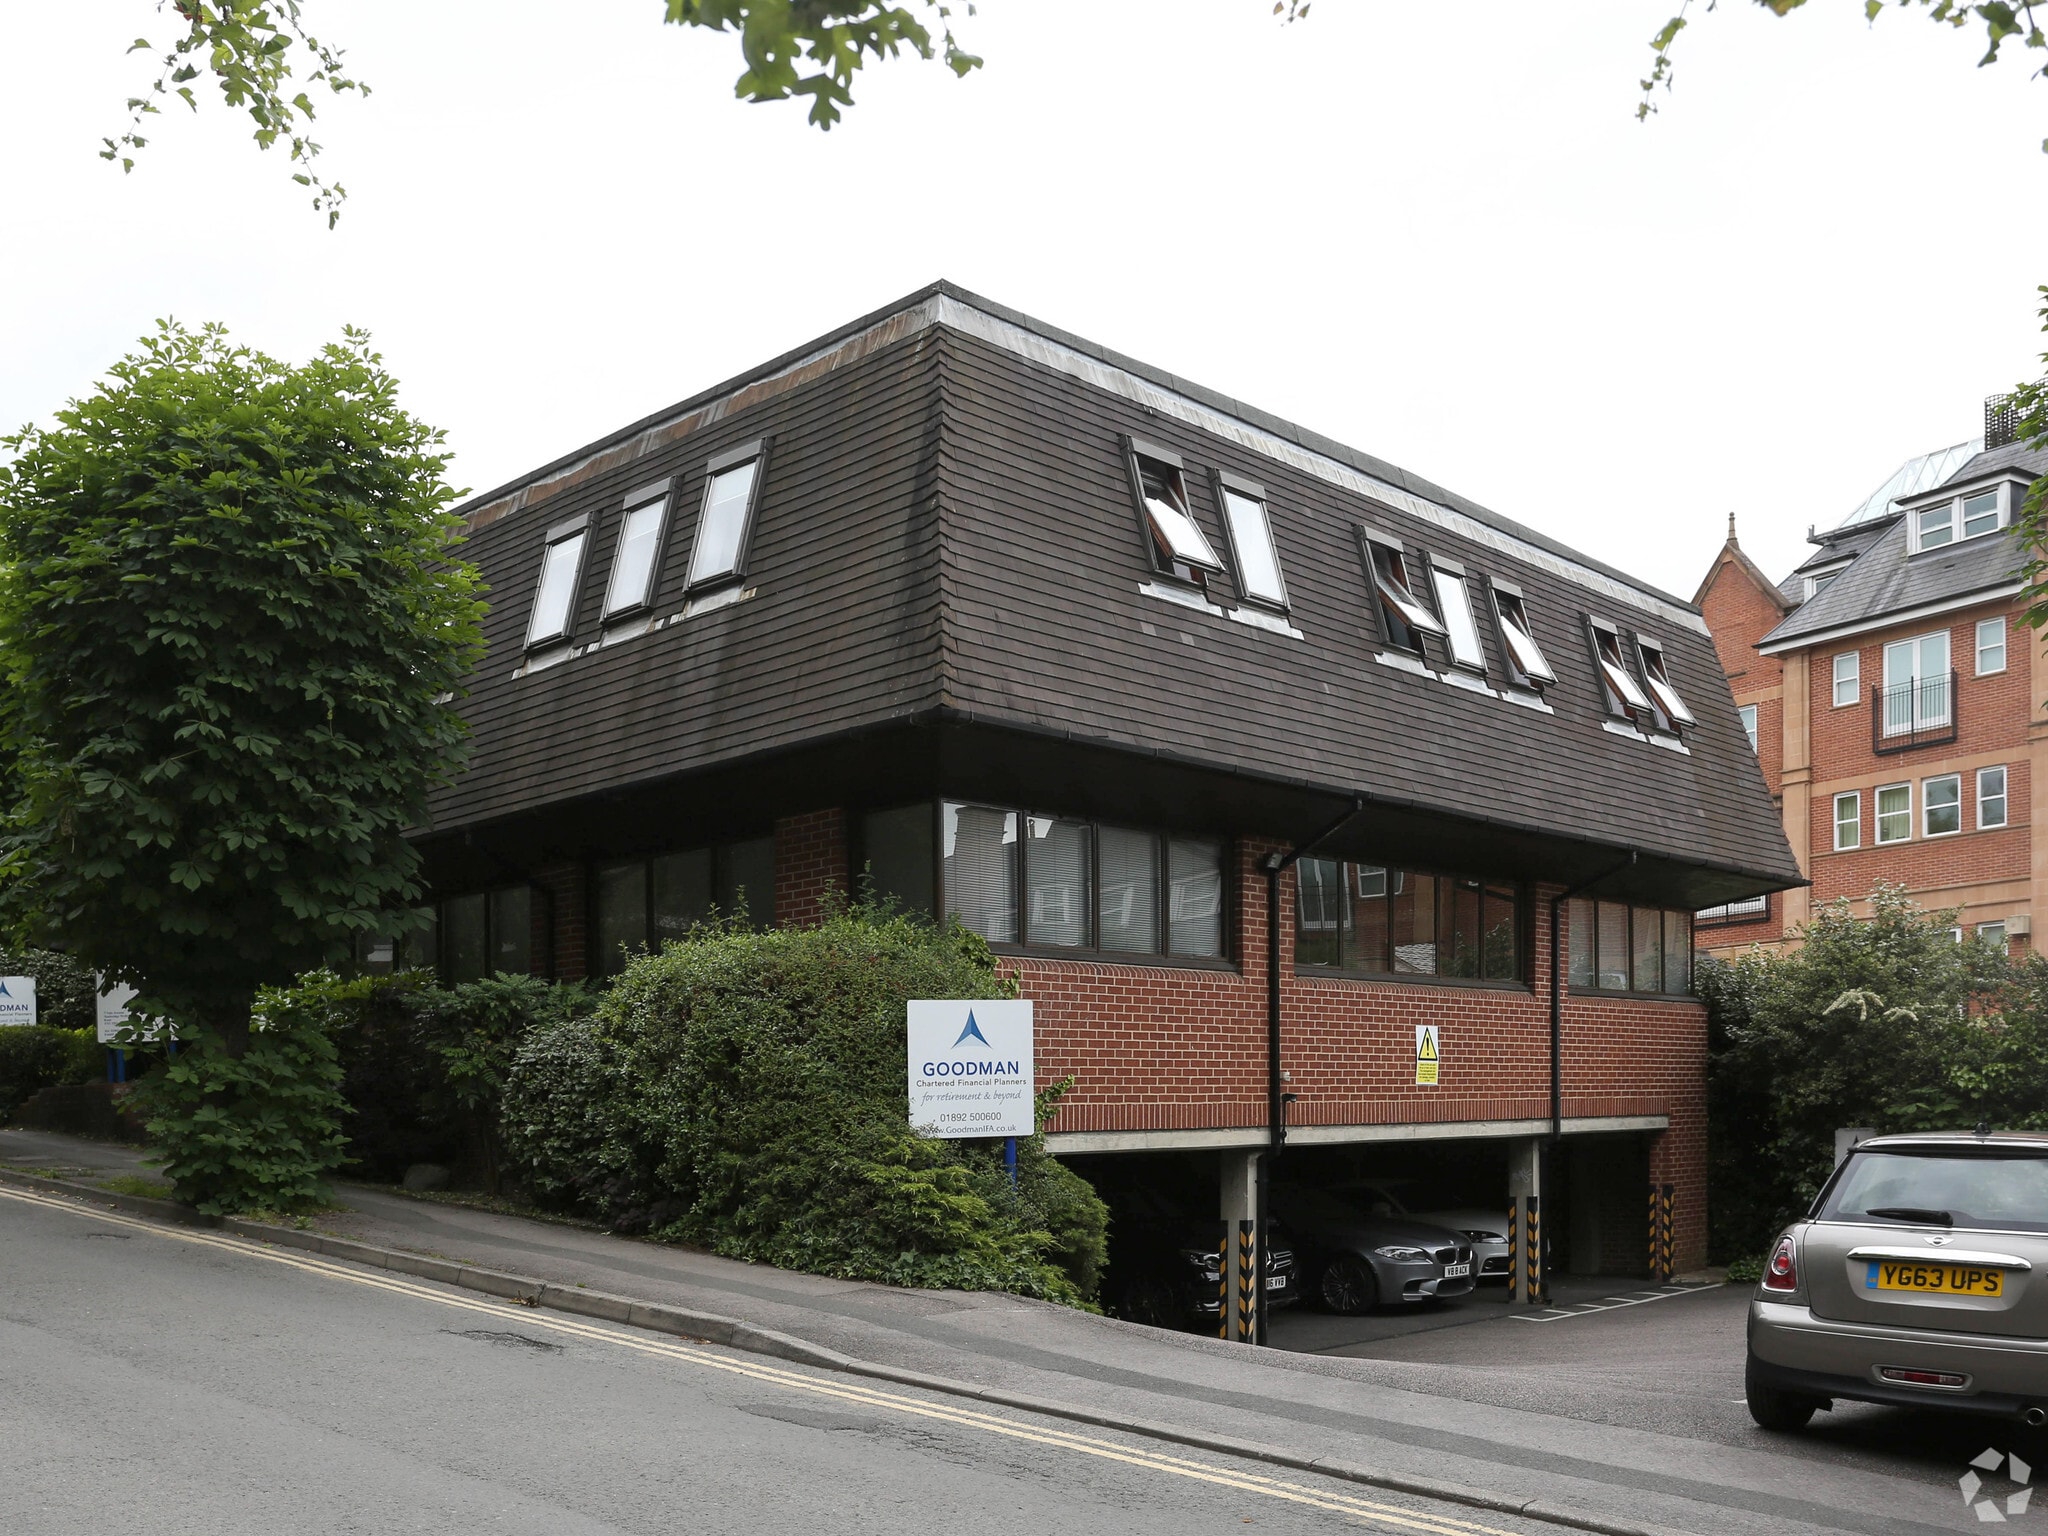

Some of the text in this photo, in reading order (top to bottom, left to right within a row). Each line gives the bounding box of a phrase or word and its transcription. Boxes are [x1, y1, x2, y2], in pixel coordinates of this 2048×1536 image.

[922, 1061, 1019, 1076] GOODMAN
[916, 1078, 1027, 1087] Chartered Financial Planners
[920, 1089, 1022, 1107] for retirement & beyond
[940, 1112, 1002, 1122] 01892 500600
[1884, 1265, 1999, 1292] YG63 UPS
